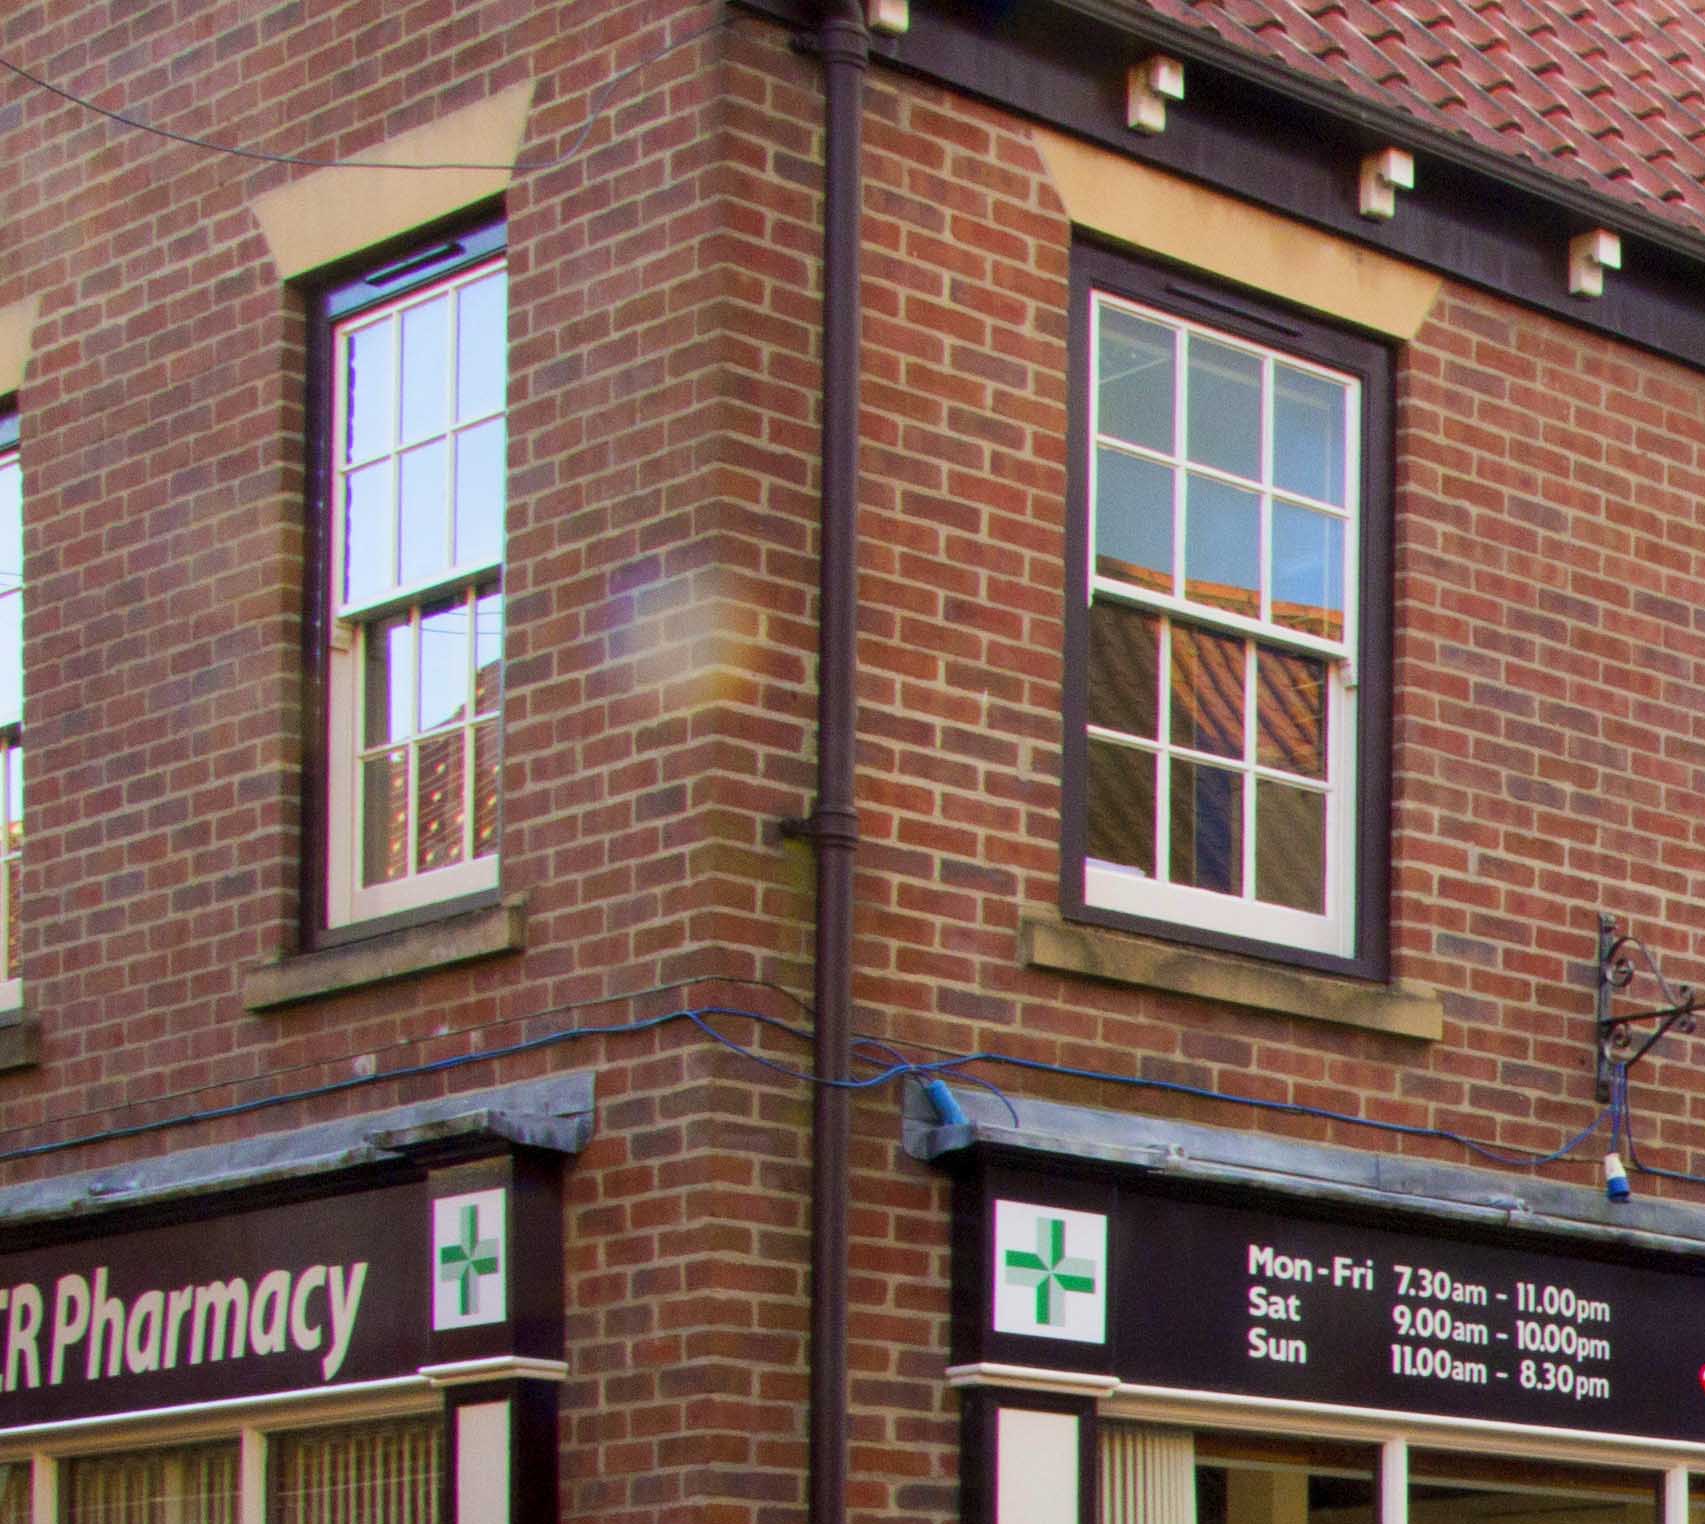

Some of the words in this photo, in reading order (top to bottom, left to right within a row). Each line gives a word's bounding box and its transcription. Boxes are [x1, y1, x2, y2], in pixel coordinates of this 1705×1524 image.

[50, 1262, 368, 1382] Pharmacy
[1248, 1244, 1312, 1282] Mon
[1333, 1256, 1374, 1290] Fri
[1393, 1265, 1487, 1306] 7.30am
[1516, 1282, 1611, 1323] 11.00pm
[1248, 1286, 1301, 1322] Sat
[1392, 1305, 1488, 1345] 9.00am
[1516, 1320, 1611, 1361] 10.00pm
[1248, 1327, 1307, 1364] Sun
[1391, 1344, 1488, 1384] 11.00am
[1520, 1360, 1611, 1400] 8.30pm
